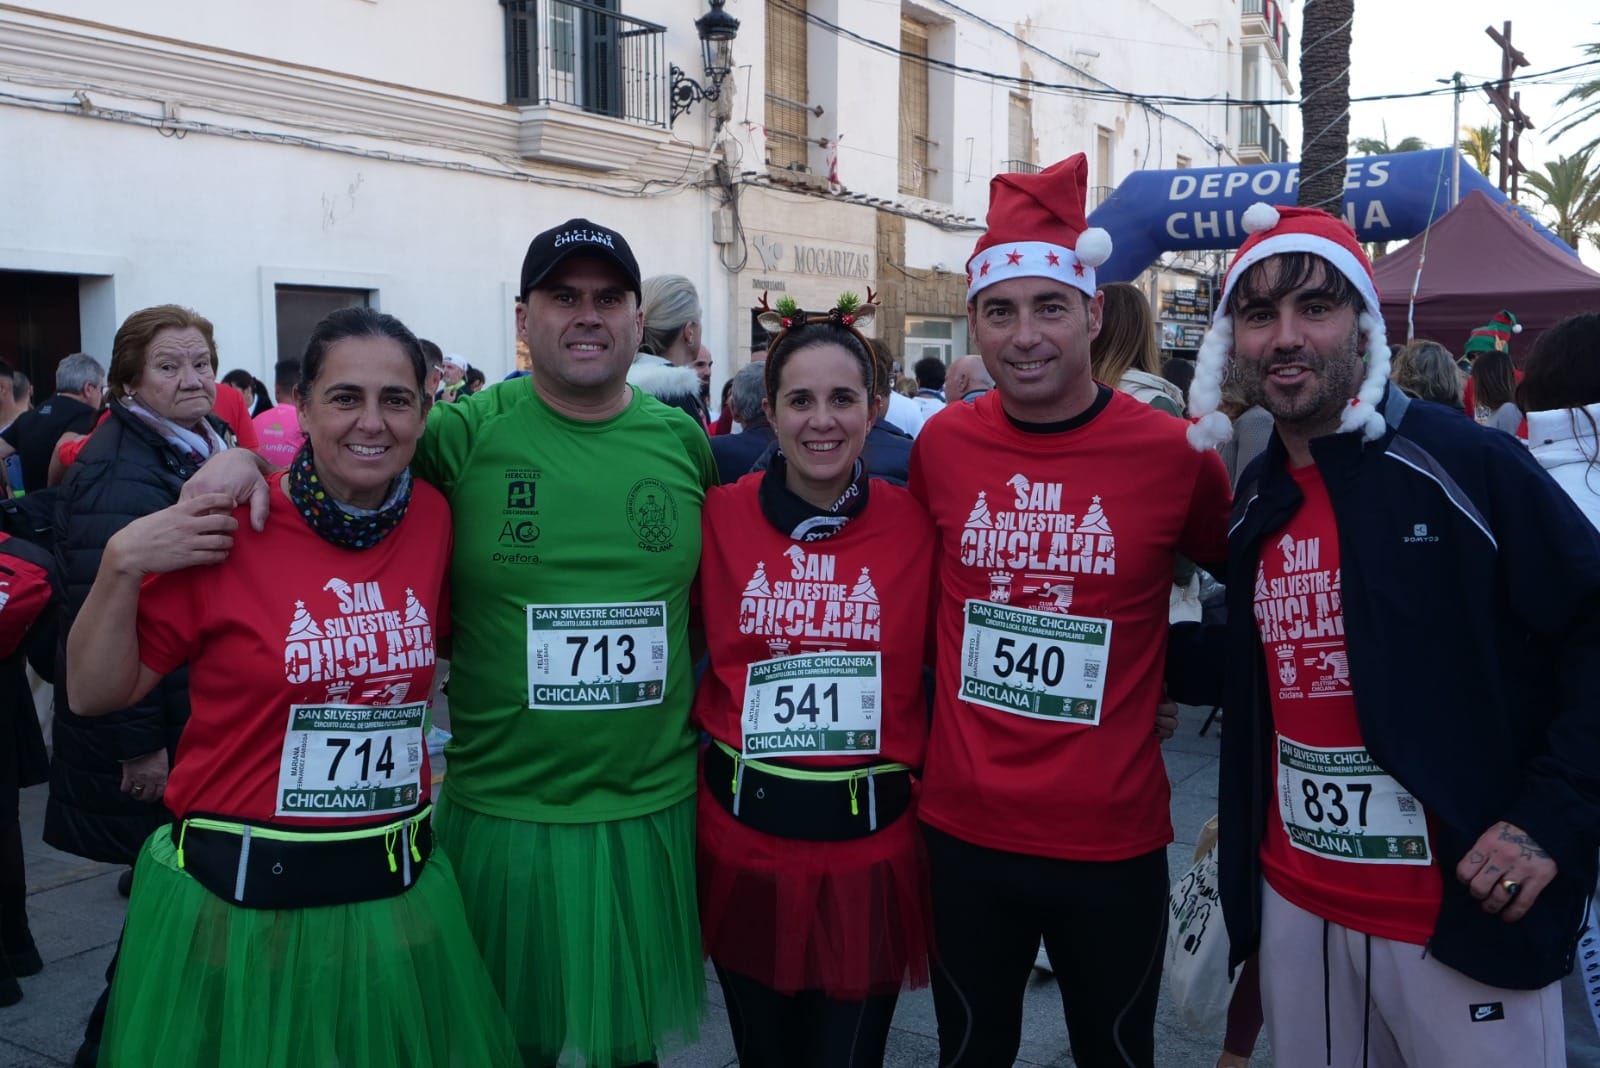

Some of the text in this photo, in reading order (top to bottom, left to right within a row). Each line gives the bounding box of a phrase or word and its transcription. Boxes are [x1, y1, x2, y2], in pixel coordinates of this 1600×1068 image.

[1168, 160, 1391, 201] DEPORES
[554, 233, 616, 250] CHICLANA
[555, 229, 613, 241] DESTINO
[794, 245, 869, 279] MOGARIZAS
[1014, 482, 1063, 512] SAN
[995, 511, 1076, 533] SILVESTRE
[638, 541, 674, 552] CHICLANA
[960, 529, 1116, 575] CHICLANA
[1283, 537, 1320, 574] SAN
[791, 553, 836, 582] SAN
[338, 581, 385, 614] SAN
[773, 581, 848, 601] SILVESTRE
[1270, 570, 1332, 599] SILVESTRE
[323, 610, 404, 638] SILVESTRE
[536, 607, 661, 620] SAN SILVESTRE CHICLANERA
[740, 598, 880, 642] CHICLANA
[972, 604, 1103, 634] SAN SILVESTRE CHICLANERA
[1006, 622, 1020, 631] LOCAL
[284, 626, 436, 684] CHICLANA
[566, 634, 636, 677] 713
[753, 657, 873, 676] SAN SILVESTRE CHICLANERA
[993, 636, 1065, 687] 540
[536, 687, 611, 702] CHICLANA
[773, 682, 839, 724] 541
[966, 681, 1030, 709] CHICLANA
[1279, 690, 1304, 700] Chiclana
[297, 708, 421, 721] SAN SILVESTRE CHICLANERA
[747, 734, 816, 750] CHICLANA
[1281, 742, 1374, 765] SAN SILVESTRE CHICLA
[290, 746, 300, 777] MARIANA
[326, 736, 395, 781] 714
[285, 792, 367, 808] CHICLANA
[1302, 778, 1373, 827] 837
[1290, 826, 1353, 854] CHICLANA
